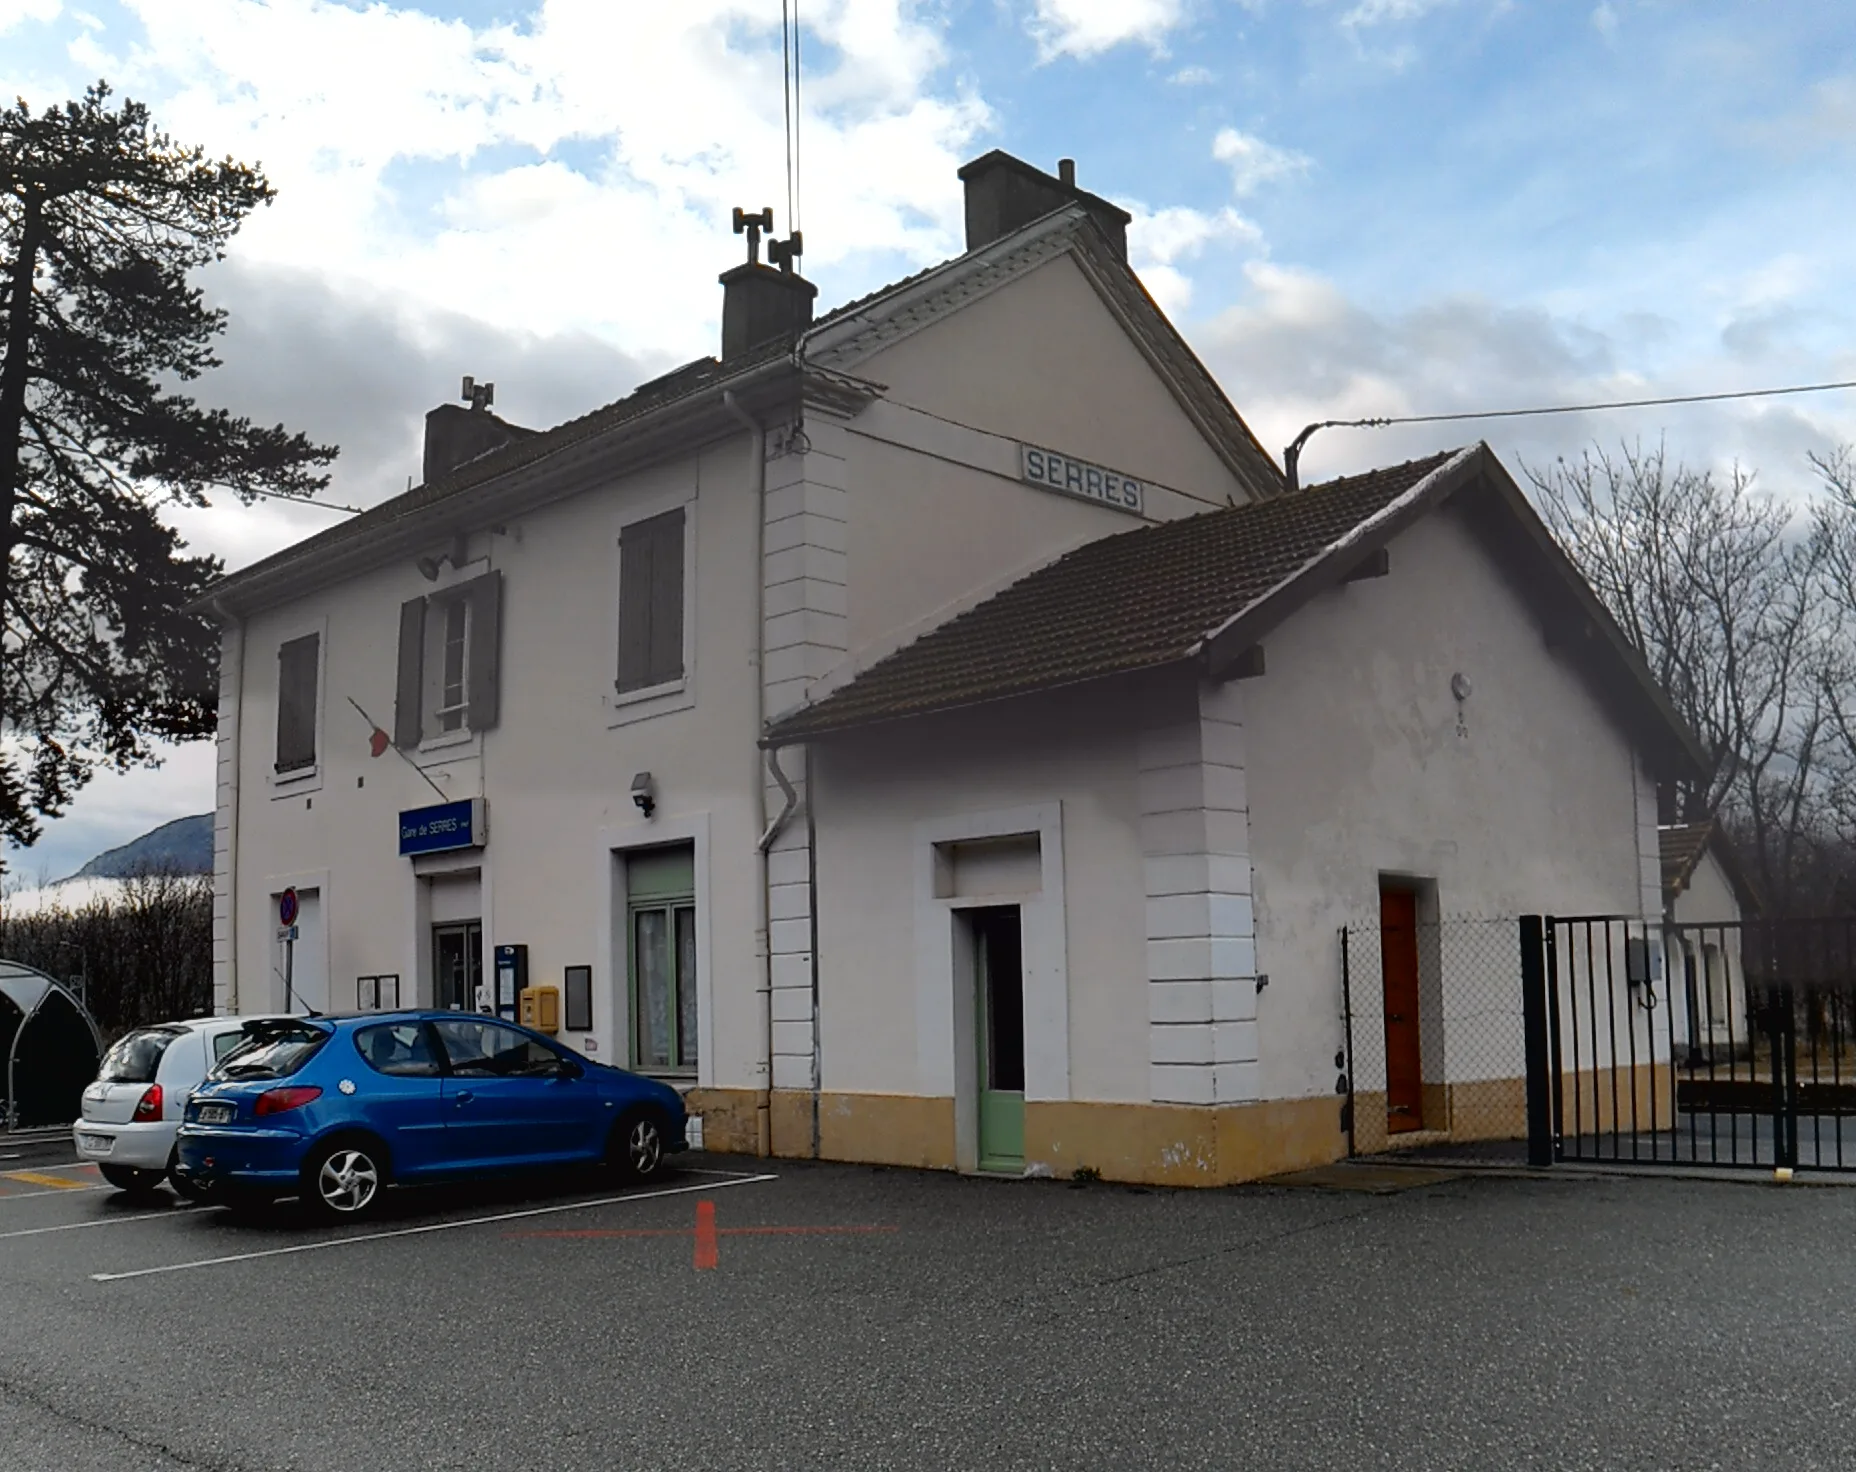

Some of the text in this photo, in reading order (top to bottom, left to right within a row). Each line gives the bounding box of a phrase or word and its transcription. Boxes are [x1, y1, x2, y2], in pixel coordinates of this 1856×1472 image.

[1028, 450, 1138, 507] SERRES
[401, 826, 417, 839] Gare
[419, 825, 428, 836] de
[429, 817, 458, 835] SERRES
